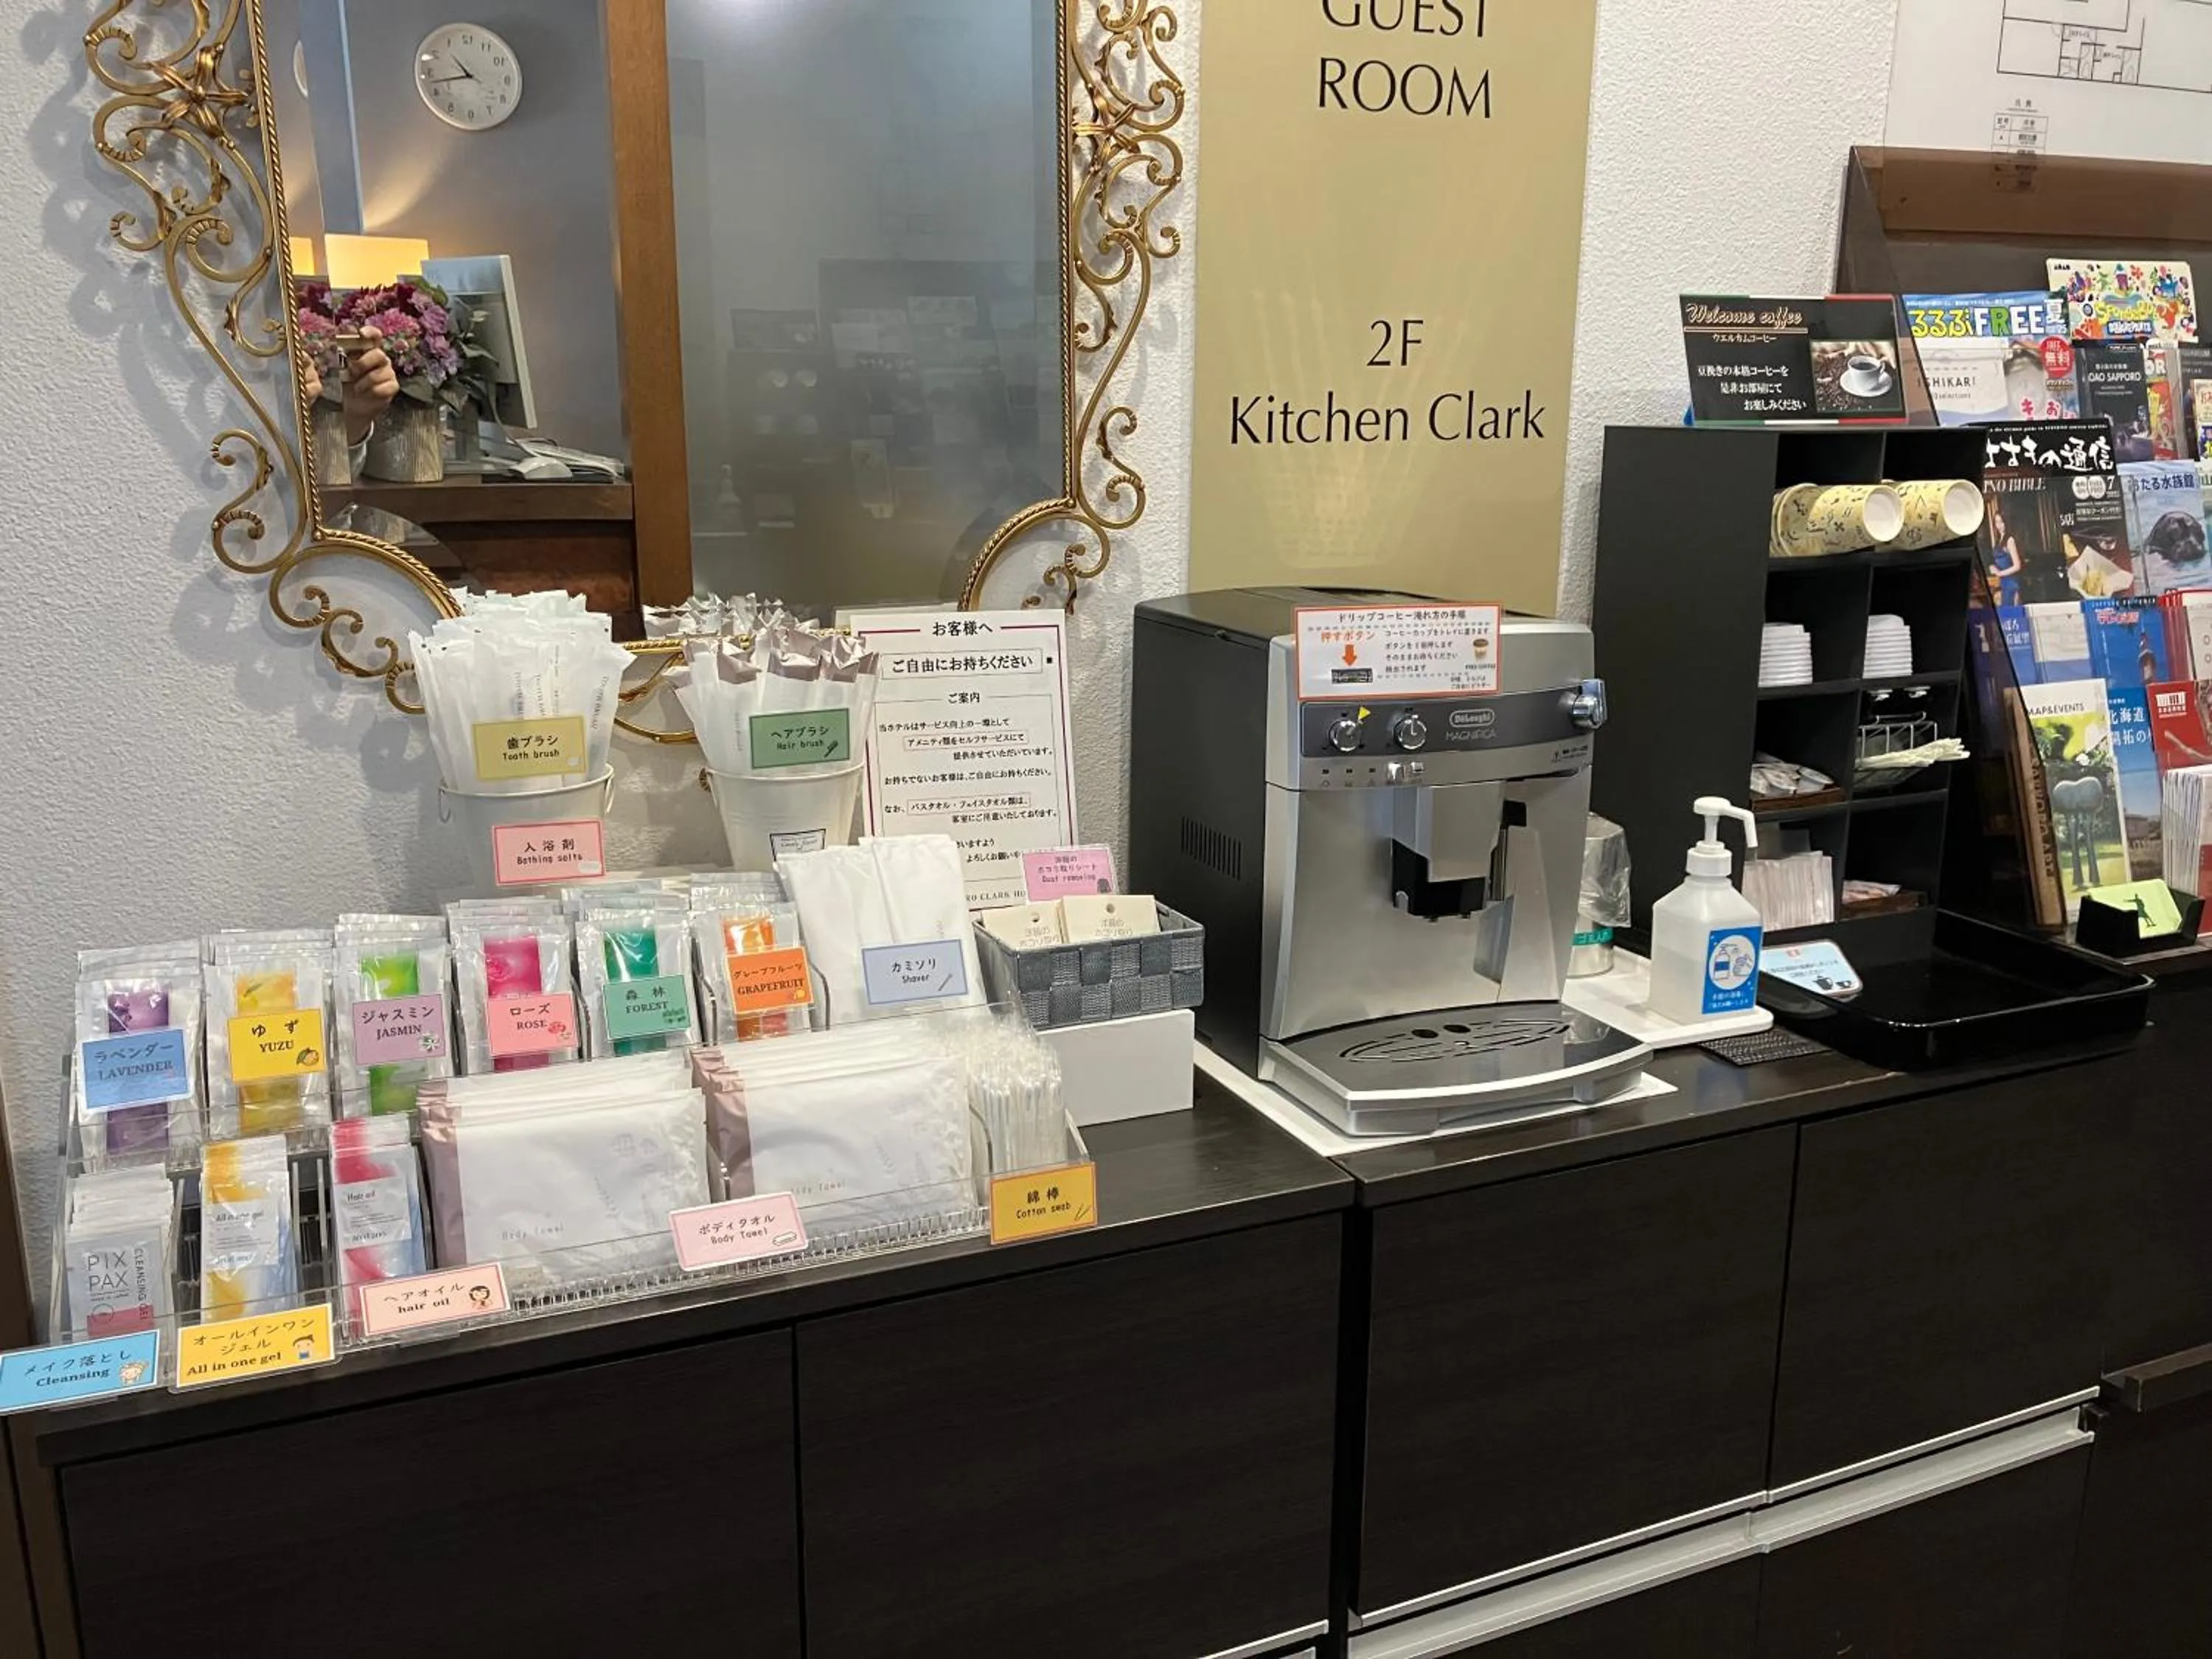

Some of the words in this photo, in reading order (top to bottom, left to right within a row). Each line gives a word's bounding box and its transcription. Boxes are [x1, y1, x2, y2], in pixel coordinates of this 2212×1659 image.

[1318, 57, 1491, 119] ROOM
[1686, 303, 1756, 324] Welcome
[1759, 306, 1803, 329] coffee
[1366, 319, 1424, 366] 2F
[2107, 371, 2142, 382] SAPPORO
[1743, 399, 1807, 411] お楽しみください
[1230, 392, 1410, 444] Kitchen
[1428, 390, 1545, 441] Clark
[932, 622, 993, 636] お客様へ
[1321, 630, 1376, 644] 押すボタン
[892, 655, 1034, 673] ご自由にお持ちください
[947, 692, 981, 703] ご案内
[771, 726, 830, 738] ヘアブラシ
[507, 735, 560, 751] 歯ブラシ
[776, 740, 796, 750] Hair
[502, 751, 529, 762] Tooth
[533, 748, 560, 760] brush
[524, 838, 576, 853] 入浴剤
[517, 853, 554, 866] Bathing
[557, 851, 583, 863] salts
[734, 962, 804, 979] グレープフルーツ
[891, 959, 937, 973] カミソリ
[737, 978, 805, 996] GRAPEFRUIT
[902, 973, 931, 984] Shaver
[625, 988, 667, 1001] 森林
[361, 1006, 435, 1025] ジャスミン
[509, 1002, 552, 1015] ローズ
[625, 1000, 669, 1015] FOREST
[251, 1018, 299, 1037] ゆず
[375, 1024, 422, 1041] JASMIN
[516, 1019, 548, 1031] ROSE
[93, 1040, 174, 1064] ラベンダー
[259, 1038, 295, 1054] YUZU
[98, 1059, 174, 1081] LAVENDER
[1016, 1207, 1047, 1220] Cotton
[1051, 1202, 1071, 1214] swab
[698, 1214, 776, 1236] ボディタオル
[711, 1233, 734, 1245] Body
[740, 1227, 768, 1239] Towel
[88, 1250, 128, 1271] PIX
[88, 1270, 128, 1293] PAX
[383, 1283, 466, 1303] ヘアオイル
[397, 1300, 426, 1314] hair
[433, 1298, 451, 1309] oil
[192, 1318, 318, 1346] オールインワン
[220, 1338, 272, 1356] ジェル
[24, 1349, 132, 1378] メイク落とし
[187, 1364, 208, 1377] All
[213, 1360, 227, 1371] in
[232, 1357, 257, 1368] one
[260, 1352, 282, 1368] gel
[37, 1367, 111, 1388] Cleansing
